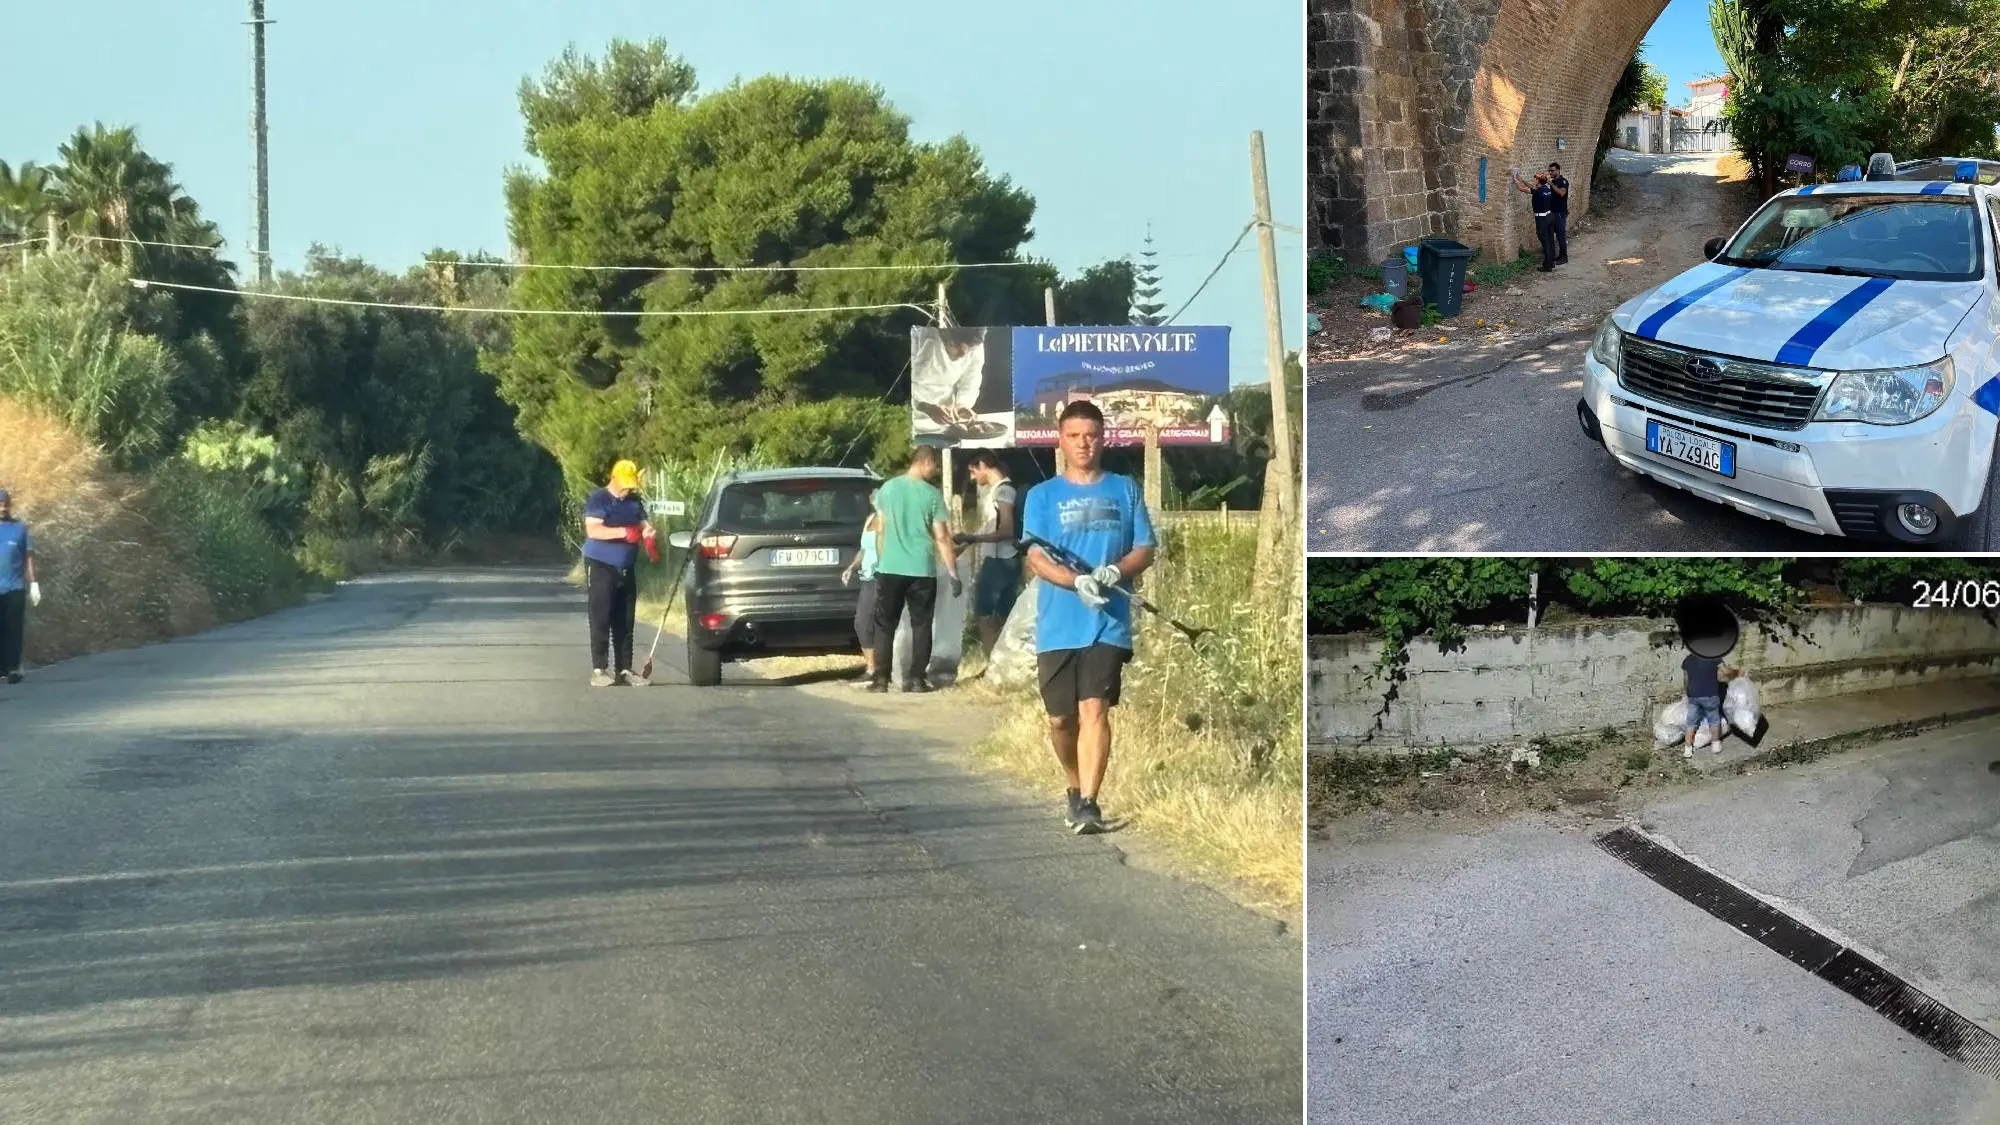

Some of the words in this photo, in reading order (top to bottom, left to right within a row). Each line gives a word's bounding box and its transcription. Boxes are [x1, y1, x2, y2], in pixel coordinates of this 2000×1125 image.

[1659, 435, 1673, 455] YA
[1679, 441, 1720, 470] 749AG
[1662, 427, 1686, 442] POLIZIA
[1689, 436, 1717, 451] LOCALE
